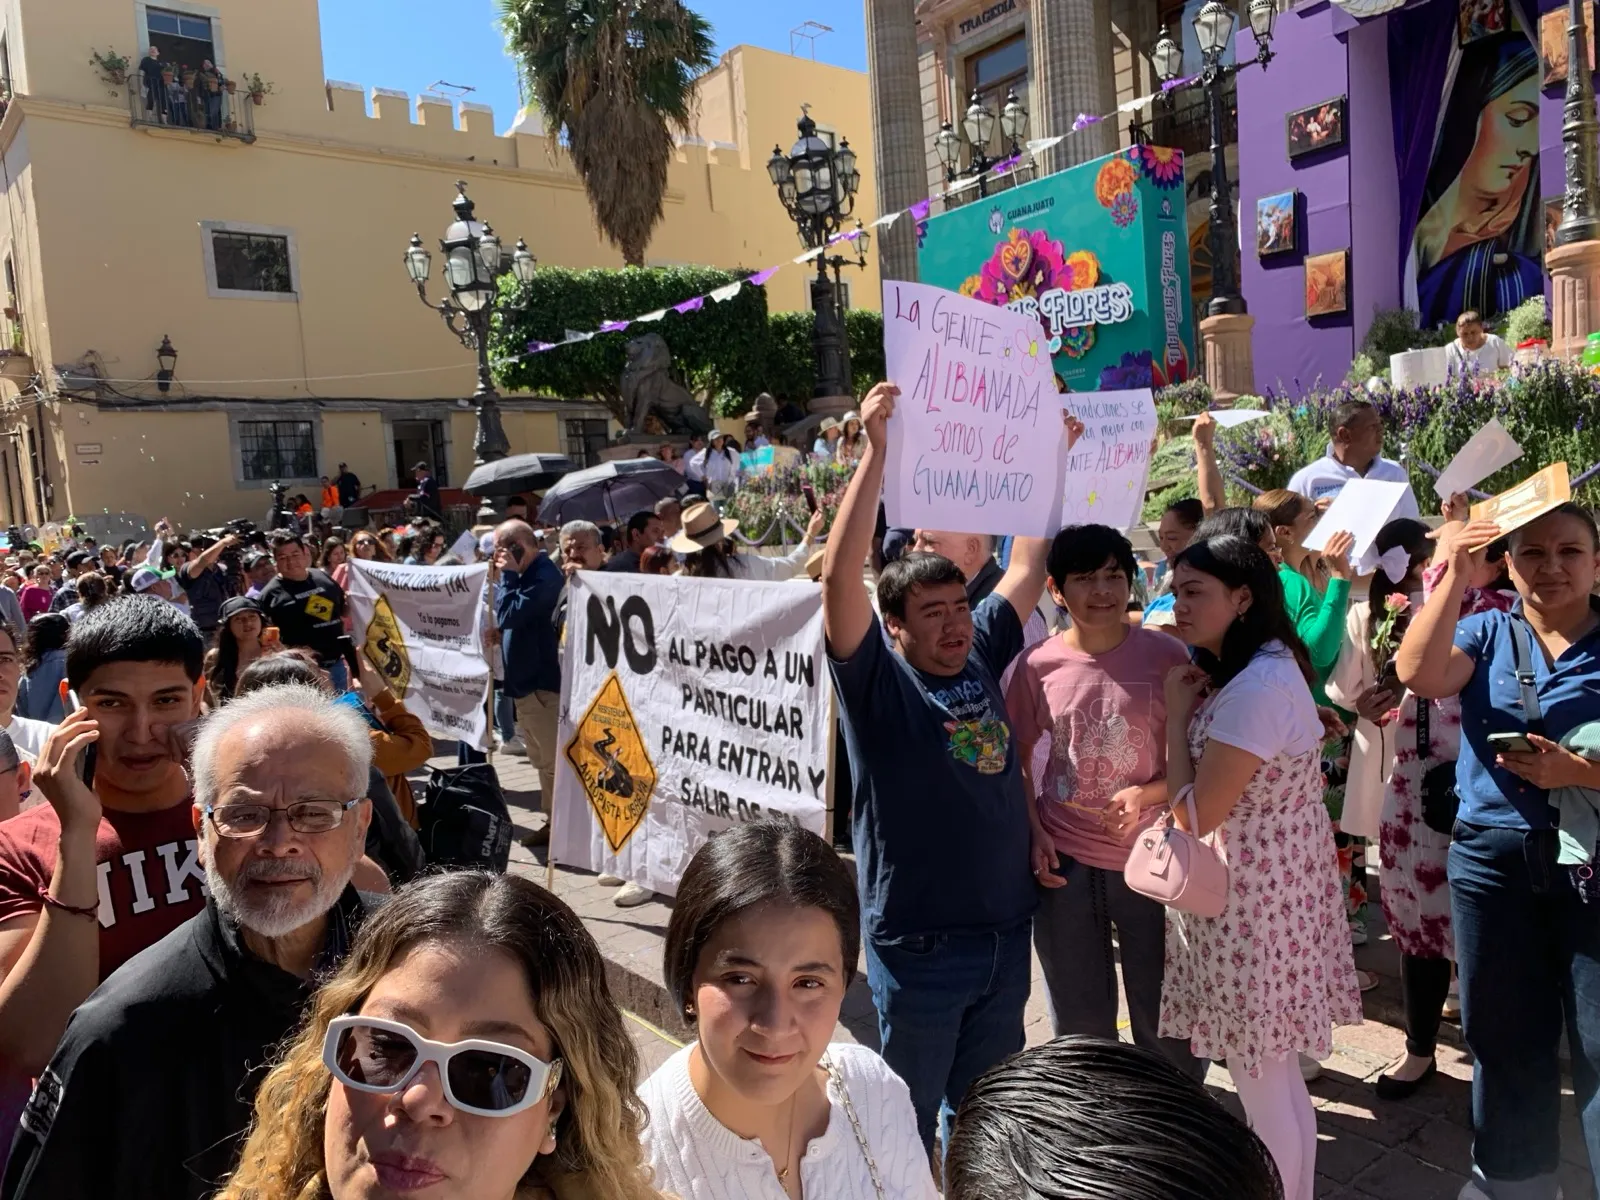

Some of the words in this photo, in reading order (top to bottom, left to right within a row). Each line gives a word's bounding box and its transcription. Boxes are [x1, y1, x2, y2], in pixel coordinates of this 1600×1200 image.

[959, 0, 1016, 35] TRAGEDIA
[1007, 196, 1055, 220] GUANAJUATO
[1161, 231, 1175, 286] FLORES
[932, 295, 1002, 356] GENTE
[1040, 283, 1133, 334] FLORES
[912, 342, 1041, 428] ALIBIANADA
[1068, 397, 1128, 419] tradiciones
[1131, 400, 1147, 415] se
[931, 421, 984, 463] somos
[992, 424, 1019, 464] de
[1101, 422, 1125, 446] mejor
[1131, 420, 1145, 432] con
[913, 454, 1034, 508] GUANAJUATO
[1066, 452, 1093, 473] ENTE
[585, 593, 657, 675] NO
[669, 637, 690, 666] AL
[694, 640, 757, 676] PAGO
[764, 648, 777, 680] A
[785, 651, 814, 687] UN
[682, 683, 804, 740] PARTICULAR
[662, 725, 711, 766] PARA
[717, 740, 801, 793] ENTRAR
[807, 766, 825, 800] Y
[579, 762, 621, 820] AUTOPISTA
[681, 777, 734, 821] SALIR
